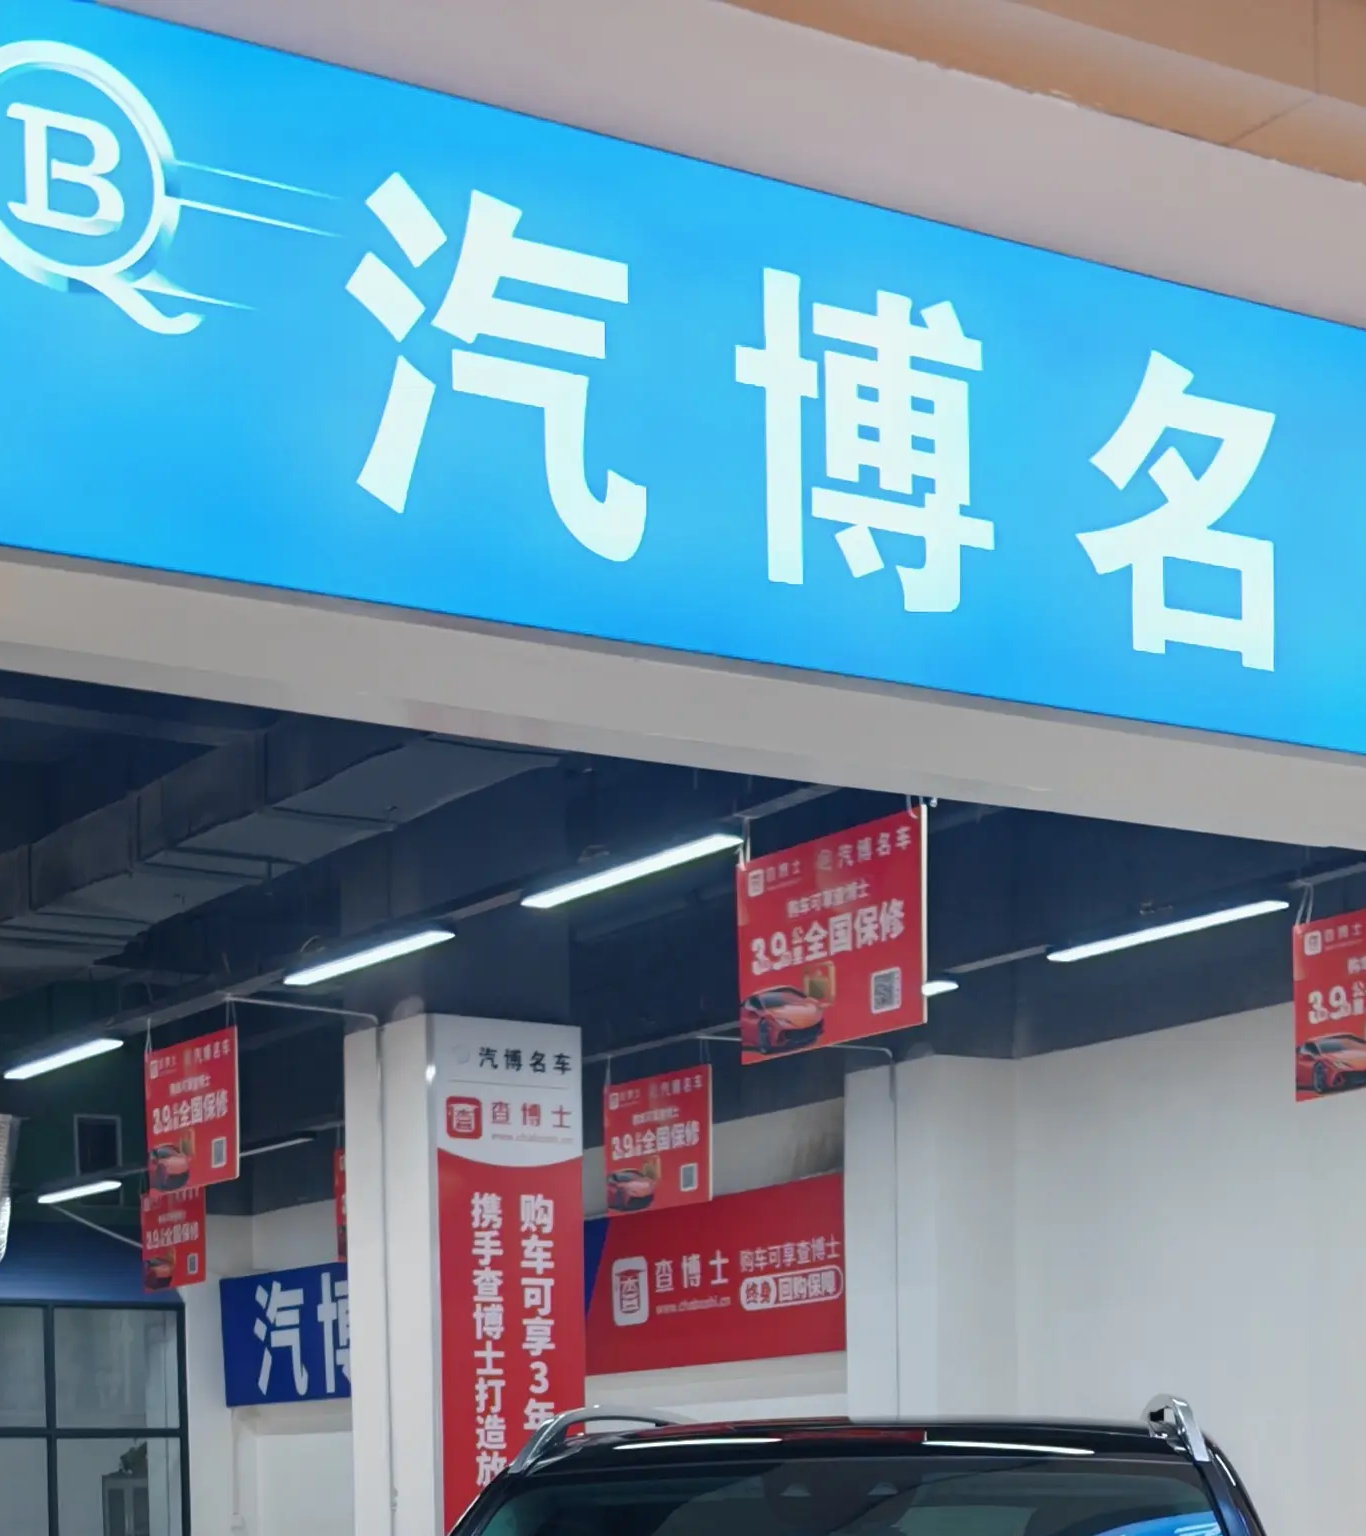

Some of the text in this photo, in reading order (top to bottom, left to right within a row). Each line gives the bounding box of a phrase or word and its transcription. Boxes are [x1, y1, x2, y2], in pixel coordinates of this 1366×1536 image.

[479, 1046, 572, 1075] 汽博名车
[740, 1235, 840, 1272] 购车可享查博士
[519, 1194, 556, 1430] 购车可享3年
